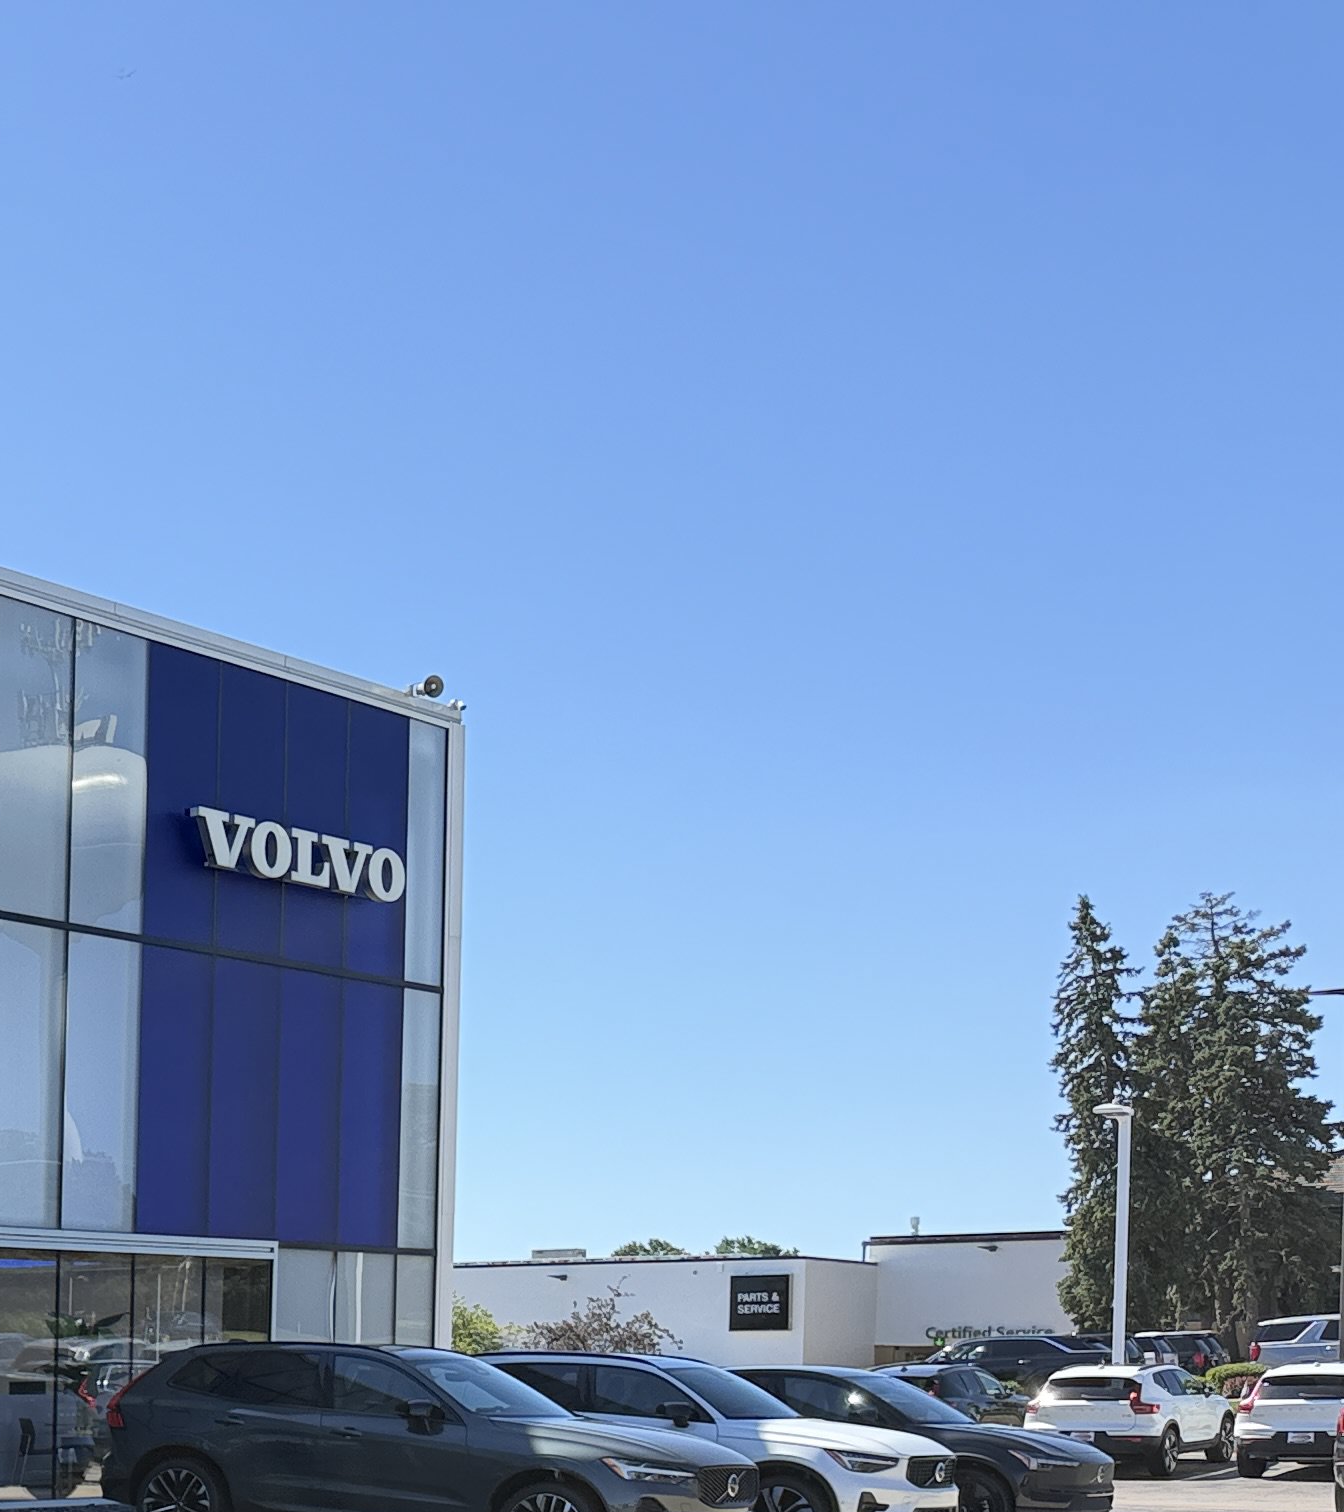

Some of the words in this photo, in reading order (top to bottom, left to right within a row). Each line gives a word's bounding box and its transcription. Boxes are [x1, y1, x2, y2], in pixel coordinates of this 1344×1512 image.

[190, 806, 405, 902] VOLVO
[737, 1292, 769, 1303] PARTS
[771, 1291, 780, 1302] &
[737, 1303, 780, 1315] SERVICE
[925, 1326, 992, 1339] Certified
